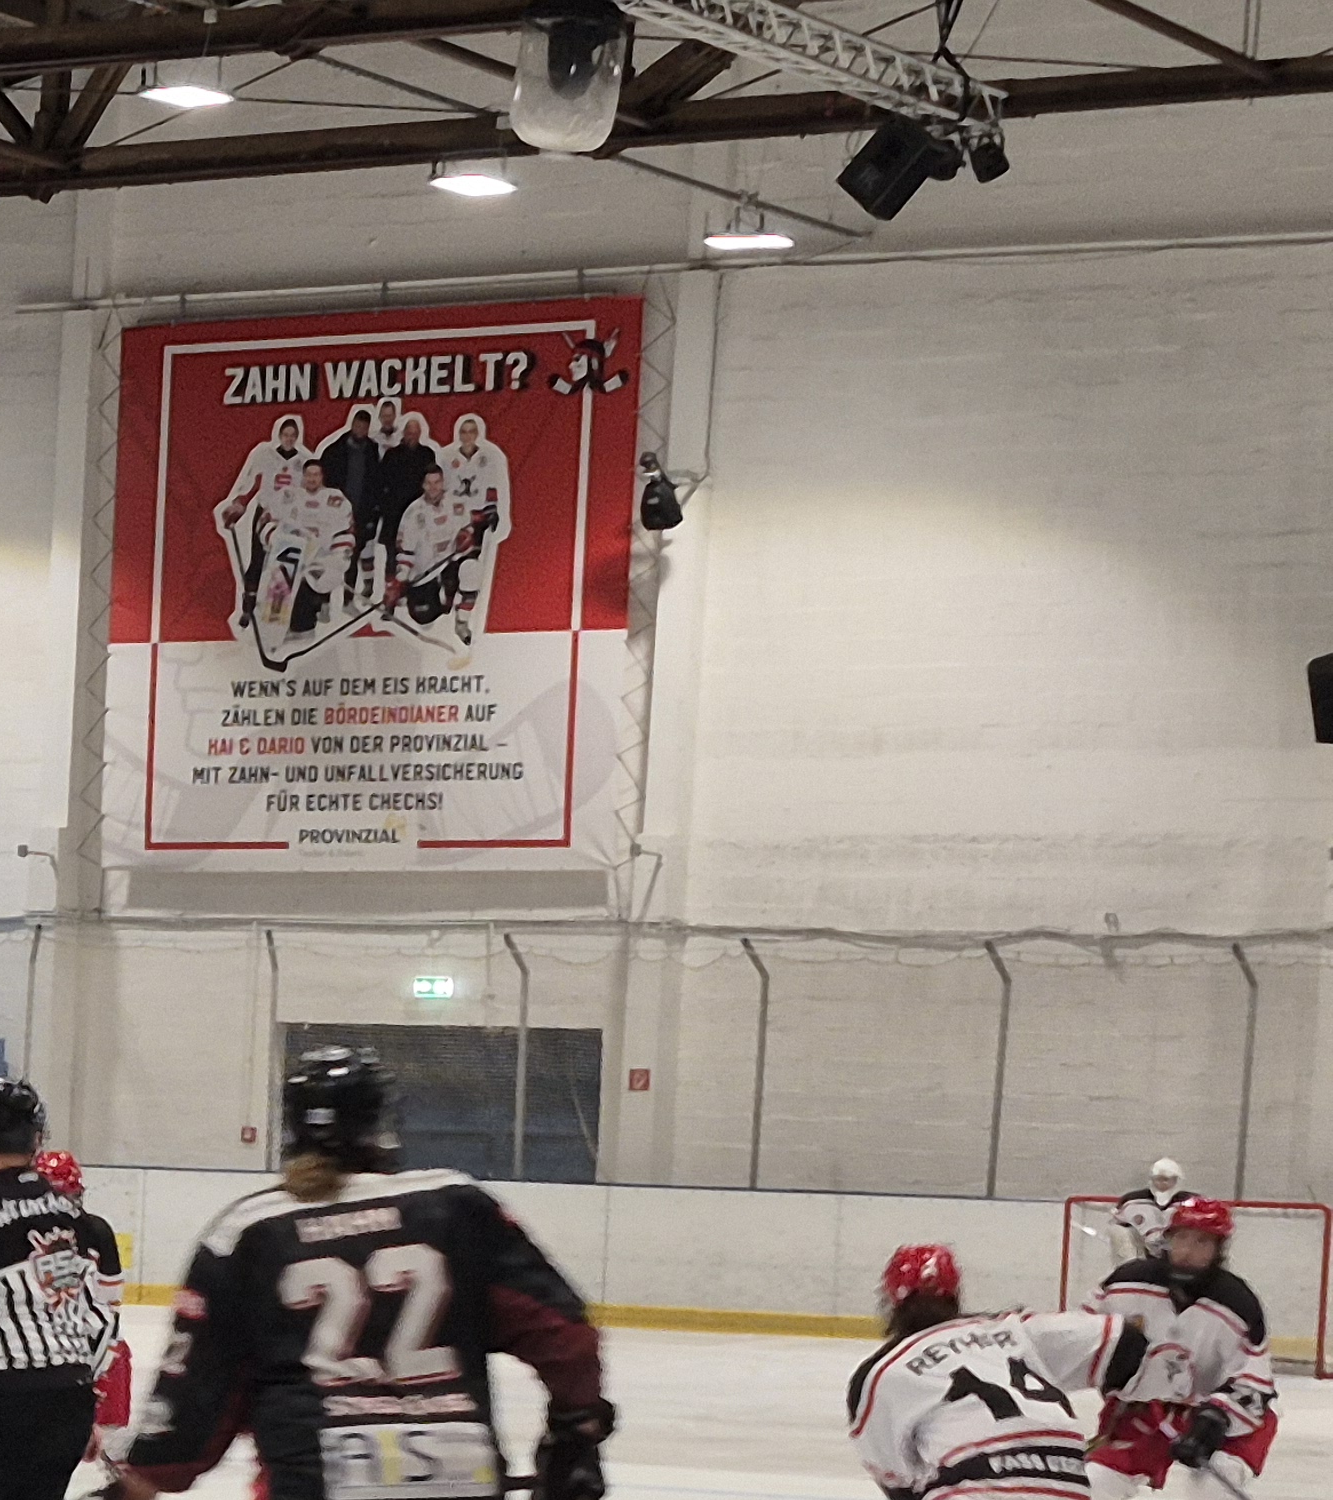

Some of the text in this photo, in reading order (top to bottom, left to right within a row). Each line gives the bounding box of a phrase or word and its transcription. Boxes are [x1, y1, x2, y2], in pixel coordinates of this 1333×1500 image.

[224, 351, 530, 405] ZAHN WACKELT?
[301, 678, 334, 697] AUF
[339, 677, 376, 696] DEM
[381, 676, 410, 695] EIS
[221, 702, 498, 727] ZÄHLEN DIE BÖRDEINDIANER AUF
[256, 736, 306, 755] DARIO
[310, 735, 344, 754] VON
[349, 735, 384, 753] DER
[389, 733, 490, 753] PROVINZIAL
[192, 762, 525, 785] MIT ZAHN- UND UNFALLVERSICHERUNG
[266, 789, 301, 812] FÜR
[305, 792, 363, 812] ECHTE
[298, 828, 401, 844] PROVINZIAL
[275, 1242, 462, 1388] 22
